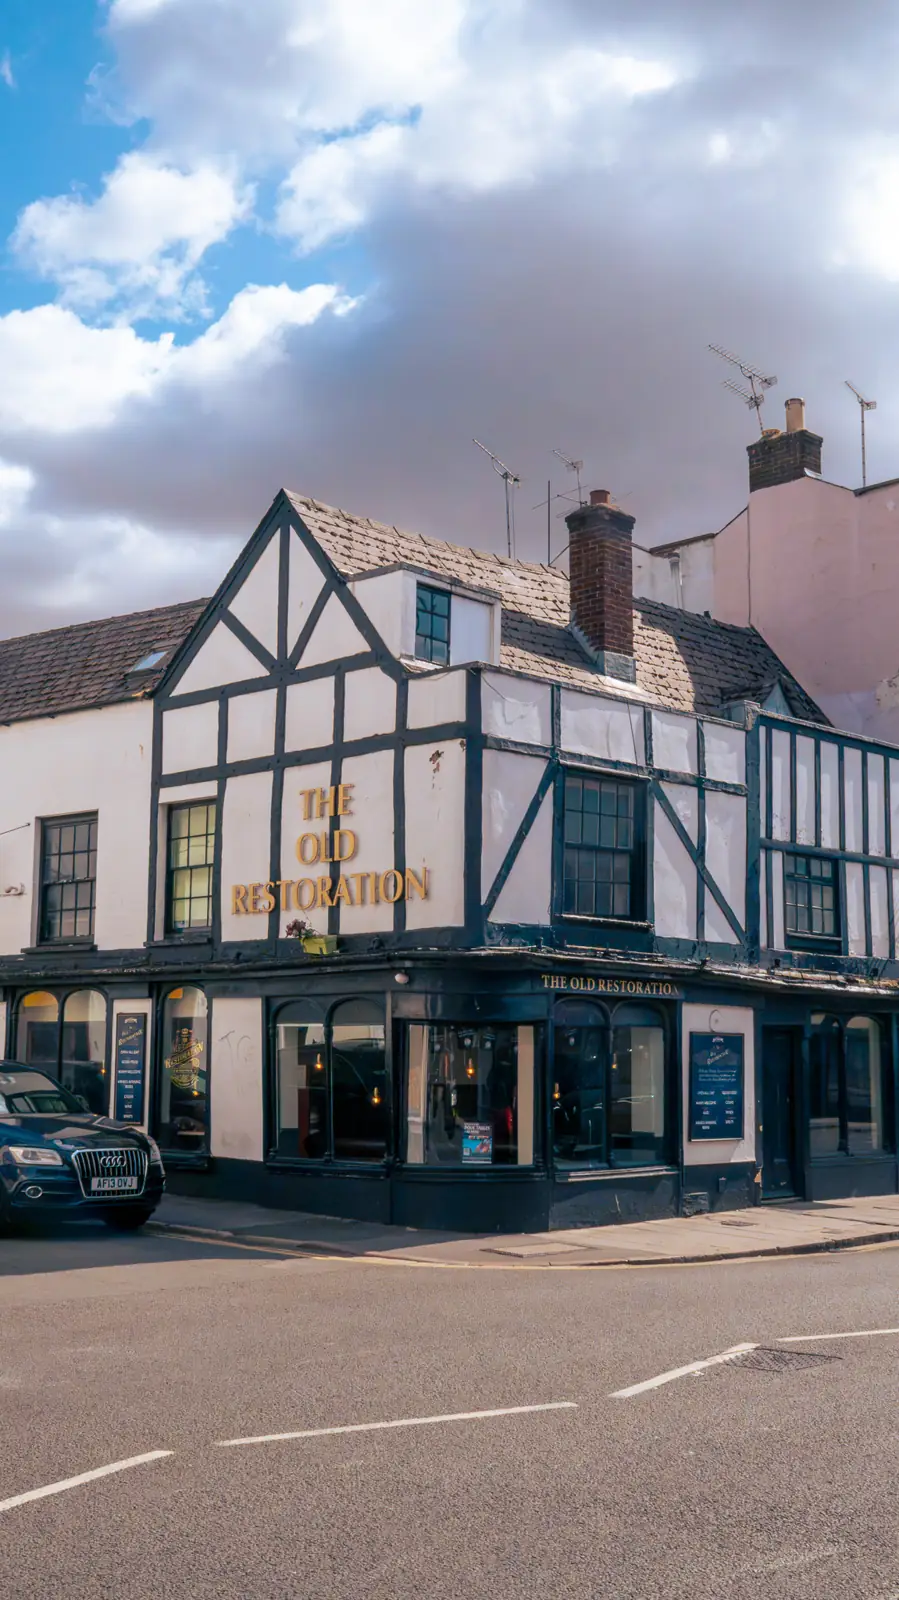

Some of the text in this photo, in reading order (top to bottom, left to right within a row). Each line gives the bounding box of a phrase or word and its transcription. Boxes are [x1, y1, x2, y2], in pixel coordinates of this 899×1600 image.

[299, 783, 355, 821] THE
[295, 829, 359, 865] OLD
[231, 867, 429, 915] RESTORATION
[541, 974, 680, 996] THE OLD RESTORATION
[97, 1178, 134, 1188] AF13 OVJ
